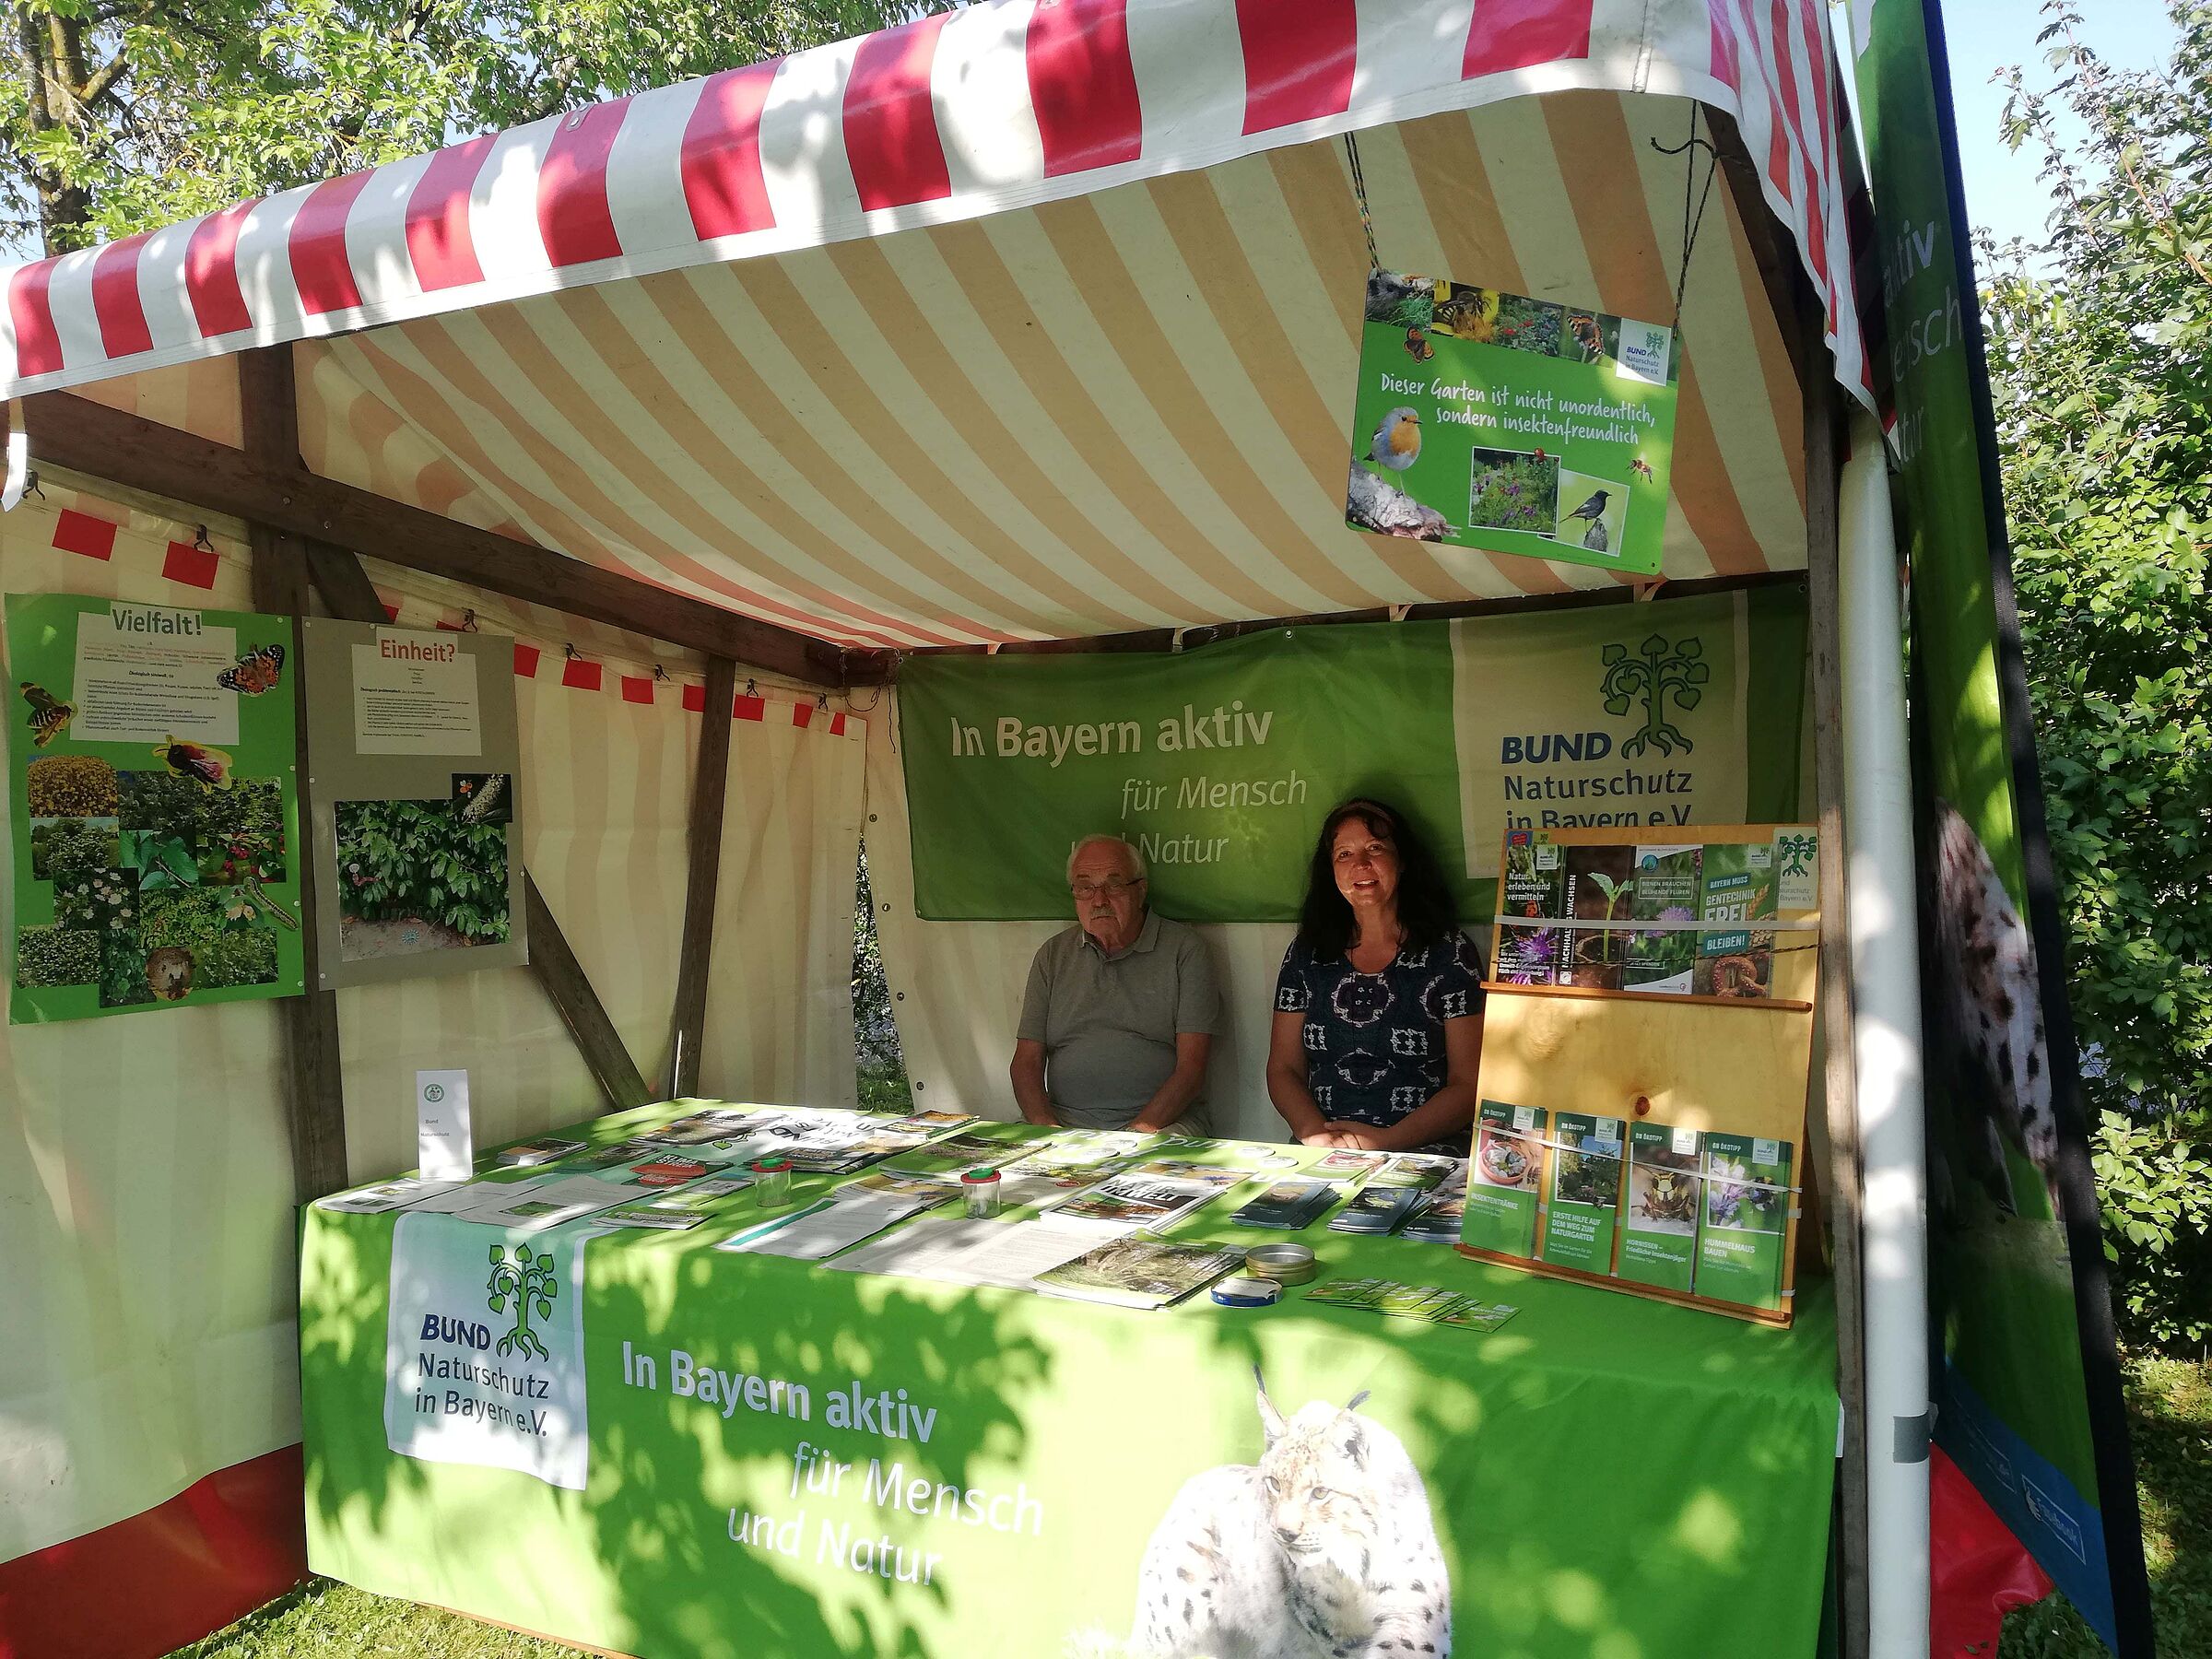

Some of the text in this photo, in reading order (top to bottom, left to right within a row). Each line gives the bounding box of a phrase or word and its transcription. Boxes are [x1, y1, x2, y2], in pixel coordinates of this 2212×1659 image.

[1625, 355, 1660, 367] Naturschutz
[1626, 346, 1647, 356] BUND
[1382, 372, 1656, 429] Dieser Garten ist nicht unordentlich,
[1436, 405, 1639, 445] sondern insektenfreundlich
[112, 608, 202, 636] Vielfalt!
[380, 639, 455, 663] Einheit?
[950, 700, 1274, 769] In Bayern aktiv
[1500, 732, 1612, 765] BUND
[1120, 769, 1307, 820] für Mensch
[1503, 768, 1694, 801] Naturschutz
[1505, 810, 1533, 830] in
[1541, 808, 1639, 830] Bayern
[1139, 832, 1230, 865] Natur
[1507, 882, 1551, 891] erleben und
[1508, 872, 1530, 881] Natur
[1710, 876, 1748, 889] BAYERN MUSS
[1507, 892, 1545, 901] vermitteln
[1566, 874, 1577, 914] WACHSEN
[1705, 888, 1757, 907] GENTECHNIK
[1706, 935, 1746, 951] BLEIBEN!
[1720, 1143, 1741, 1152] ÖKOTIPP
[1552, 1219, 1595, 1234] DEM WEG ZUM
[1553, 1211, 1602, 1226] ERSTE HILFE AUF
[1551, 1228, 1594, 1242] NATURGARTEN
[1626, 1238, 1659, 1250] HORNISSEN
[1703, 1238, 1756, 1254] HUMMELHAUS
[1703, 1247, 1728, 1258] BAUEN
[420, 1313, 491, 1351] BUND
[418, 1352, 549, 1400] Naturschutz
[622, 1339, 937, 1444] In Bayern aktiv
[415, 1386, 547, 1437] in Bayern e.V.
[789, 1441, 1044, 1537] für Mensch
[727, 1506, 945, 1587] und Natur
